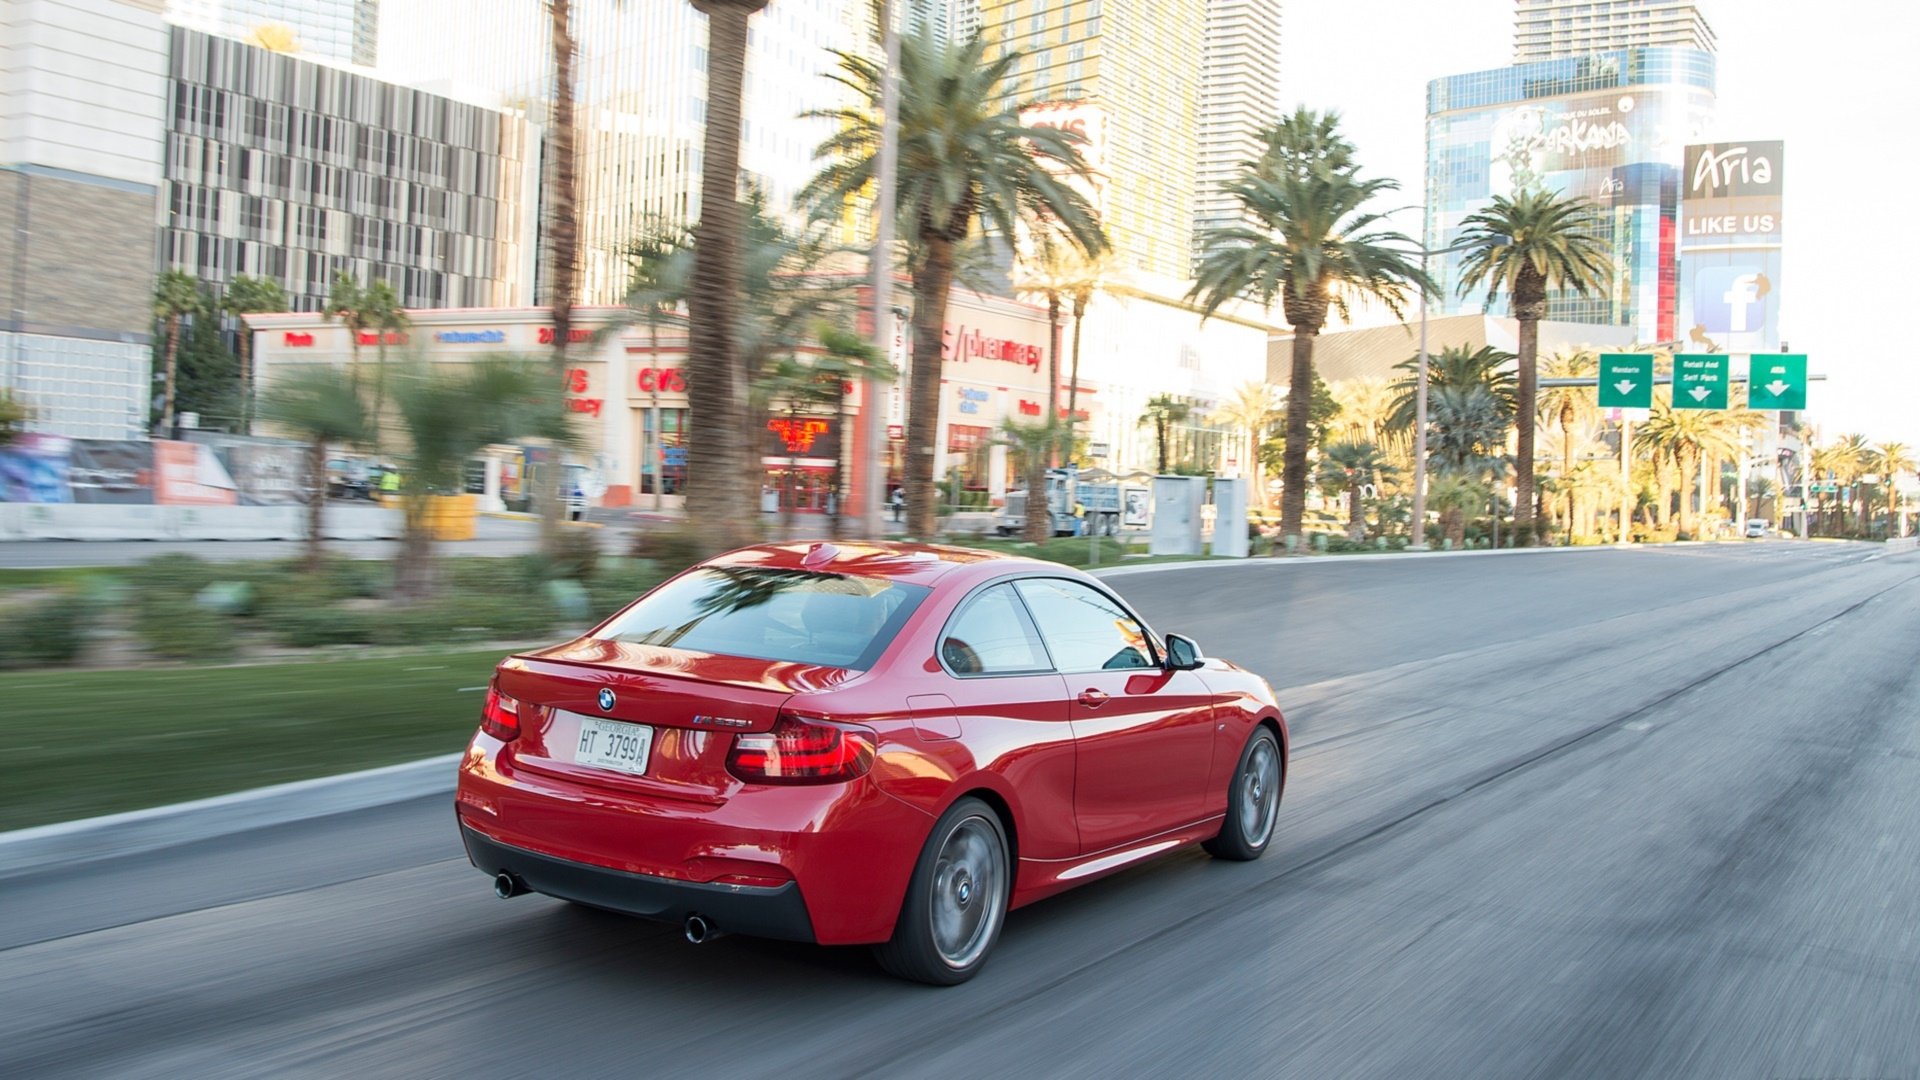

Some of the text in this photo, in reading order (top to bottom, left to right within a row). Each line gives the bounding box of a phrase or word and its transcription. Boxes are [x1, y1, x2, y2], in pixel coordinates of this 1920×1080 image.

[1693, 146, 1772, 192] Aria
[1599, 176, 1624, 195] Aria
[1688, 214, 1775, 235] LIKE US
[637, 367, 686, 392] CVS
[598, 721, 638, 736] GEORGIA
[579, 728, 646, 767] HT 3799A
